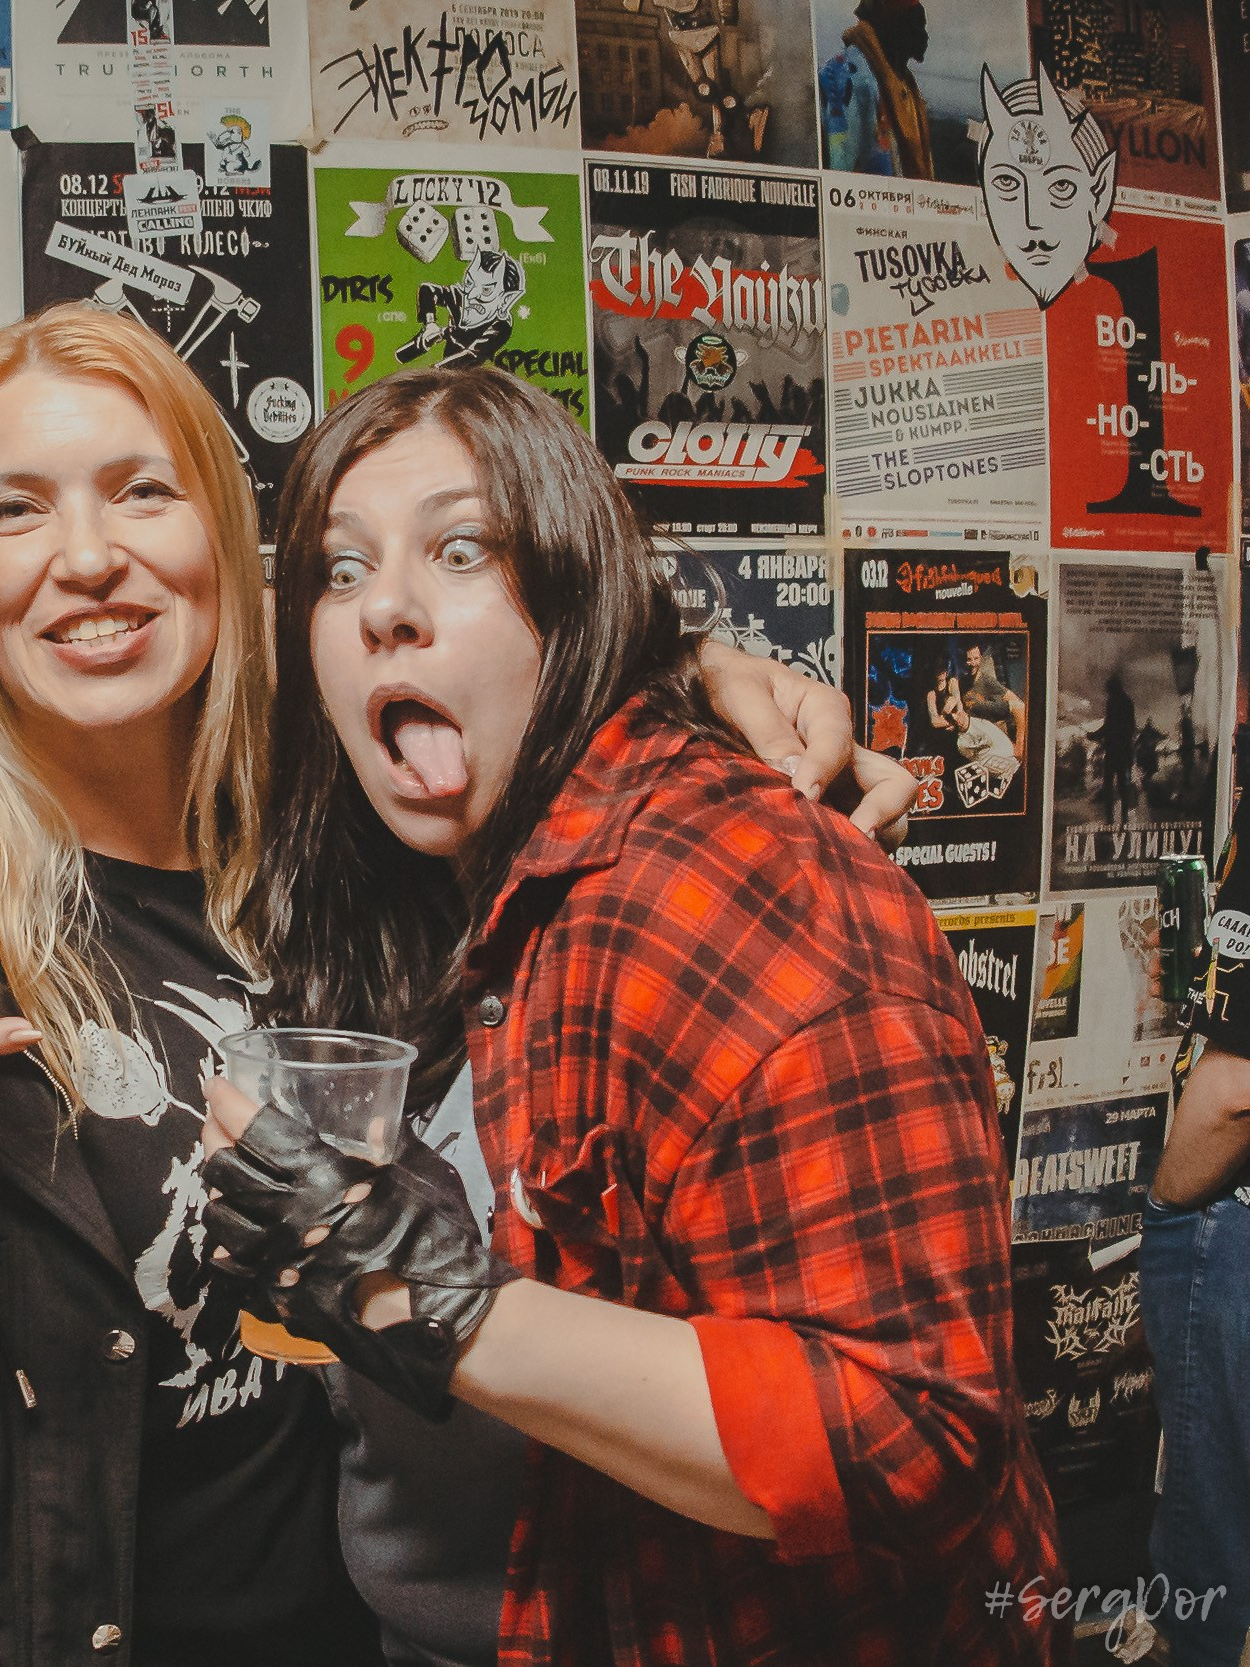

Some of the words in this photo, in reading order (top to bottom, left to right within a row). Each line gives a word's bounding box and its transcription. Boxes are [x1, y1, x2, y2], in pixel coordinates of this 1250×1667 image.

[56, 64, 130, 76] TRU
[60, 174, 108, 195] 08.12
[393, 177, 464, 204] LUCKY
[592, 168, 650, 195] 08.11.19
[670, 173, 697, 198] FISH
[701, 175, 757, 204] FABRIQUE
[760, 180, 816, 207] NOUVELLE
[829, 187, 857, 208] 06
[858, 190, 912, 203] ОКТЯБРЯ
[131, 206, 177, 219] ЛЕНПАНК
[137, 216, 195, 233] CALLING
[855, 226, 908, 239] ФИНСКАЯ
[112, 255, 138, 280] Дед
[141, 264, 182, 293] Мороз
[853, 240, 967, 283] TUSOVKA
[588, 229, 685, 320] The
[845, 314, 984, 357] PIETARIN
[334, 323, 376, 383] 9
[869, 339, 1022, 378] SPEKTAAKKELI
[854, 377, 942, 409] JUKKA
[871, 394, 996, 428] NOUSIAINEN
[909, 420, 968, 440] KUMPP.
[872, 448, 910, 471] THE
[624, 467, 656, 477] PUNK
[661, 468, 692, 477] ROCK
[696, 469, 746, 478] MANIACS
[883, 455, 999, 491] SLOPTONES
[737, 555, 752, 580] 4
[757, 555, 828, 580] ЯНВАРЯ
[776, 582, 831, 607] 20:00
[935, 582, 974, 600] nouvelle
[895, 844, 944, 866] SPECIAL
[1065, 832, 1096, 862] НА
[973, 912, 1016, 927] presents
